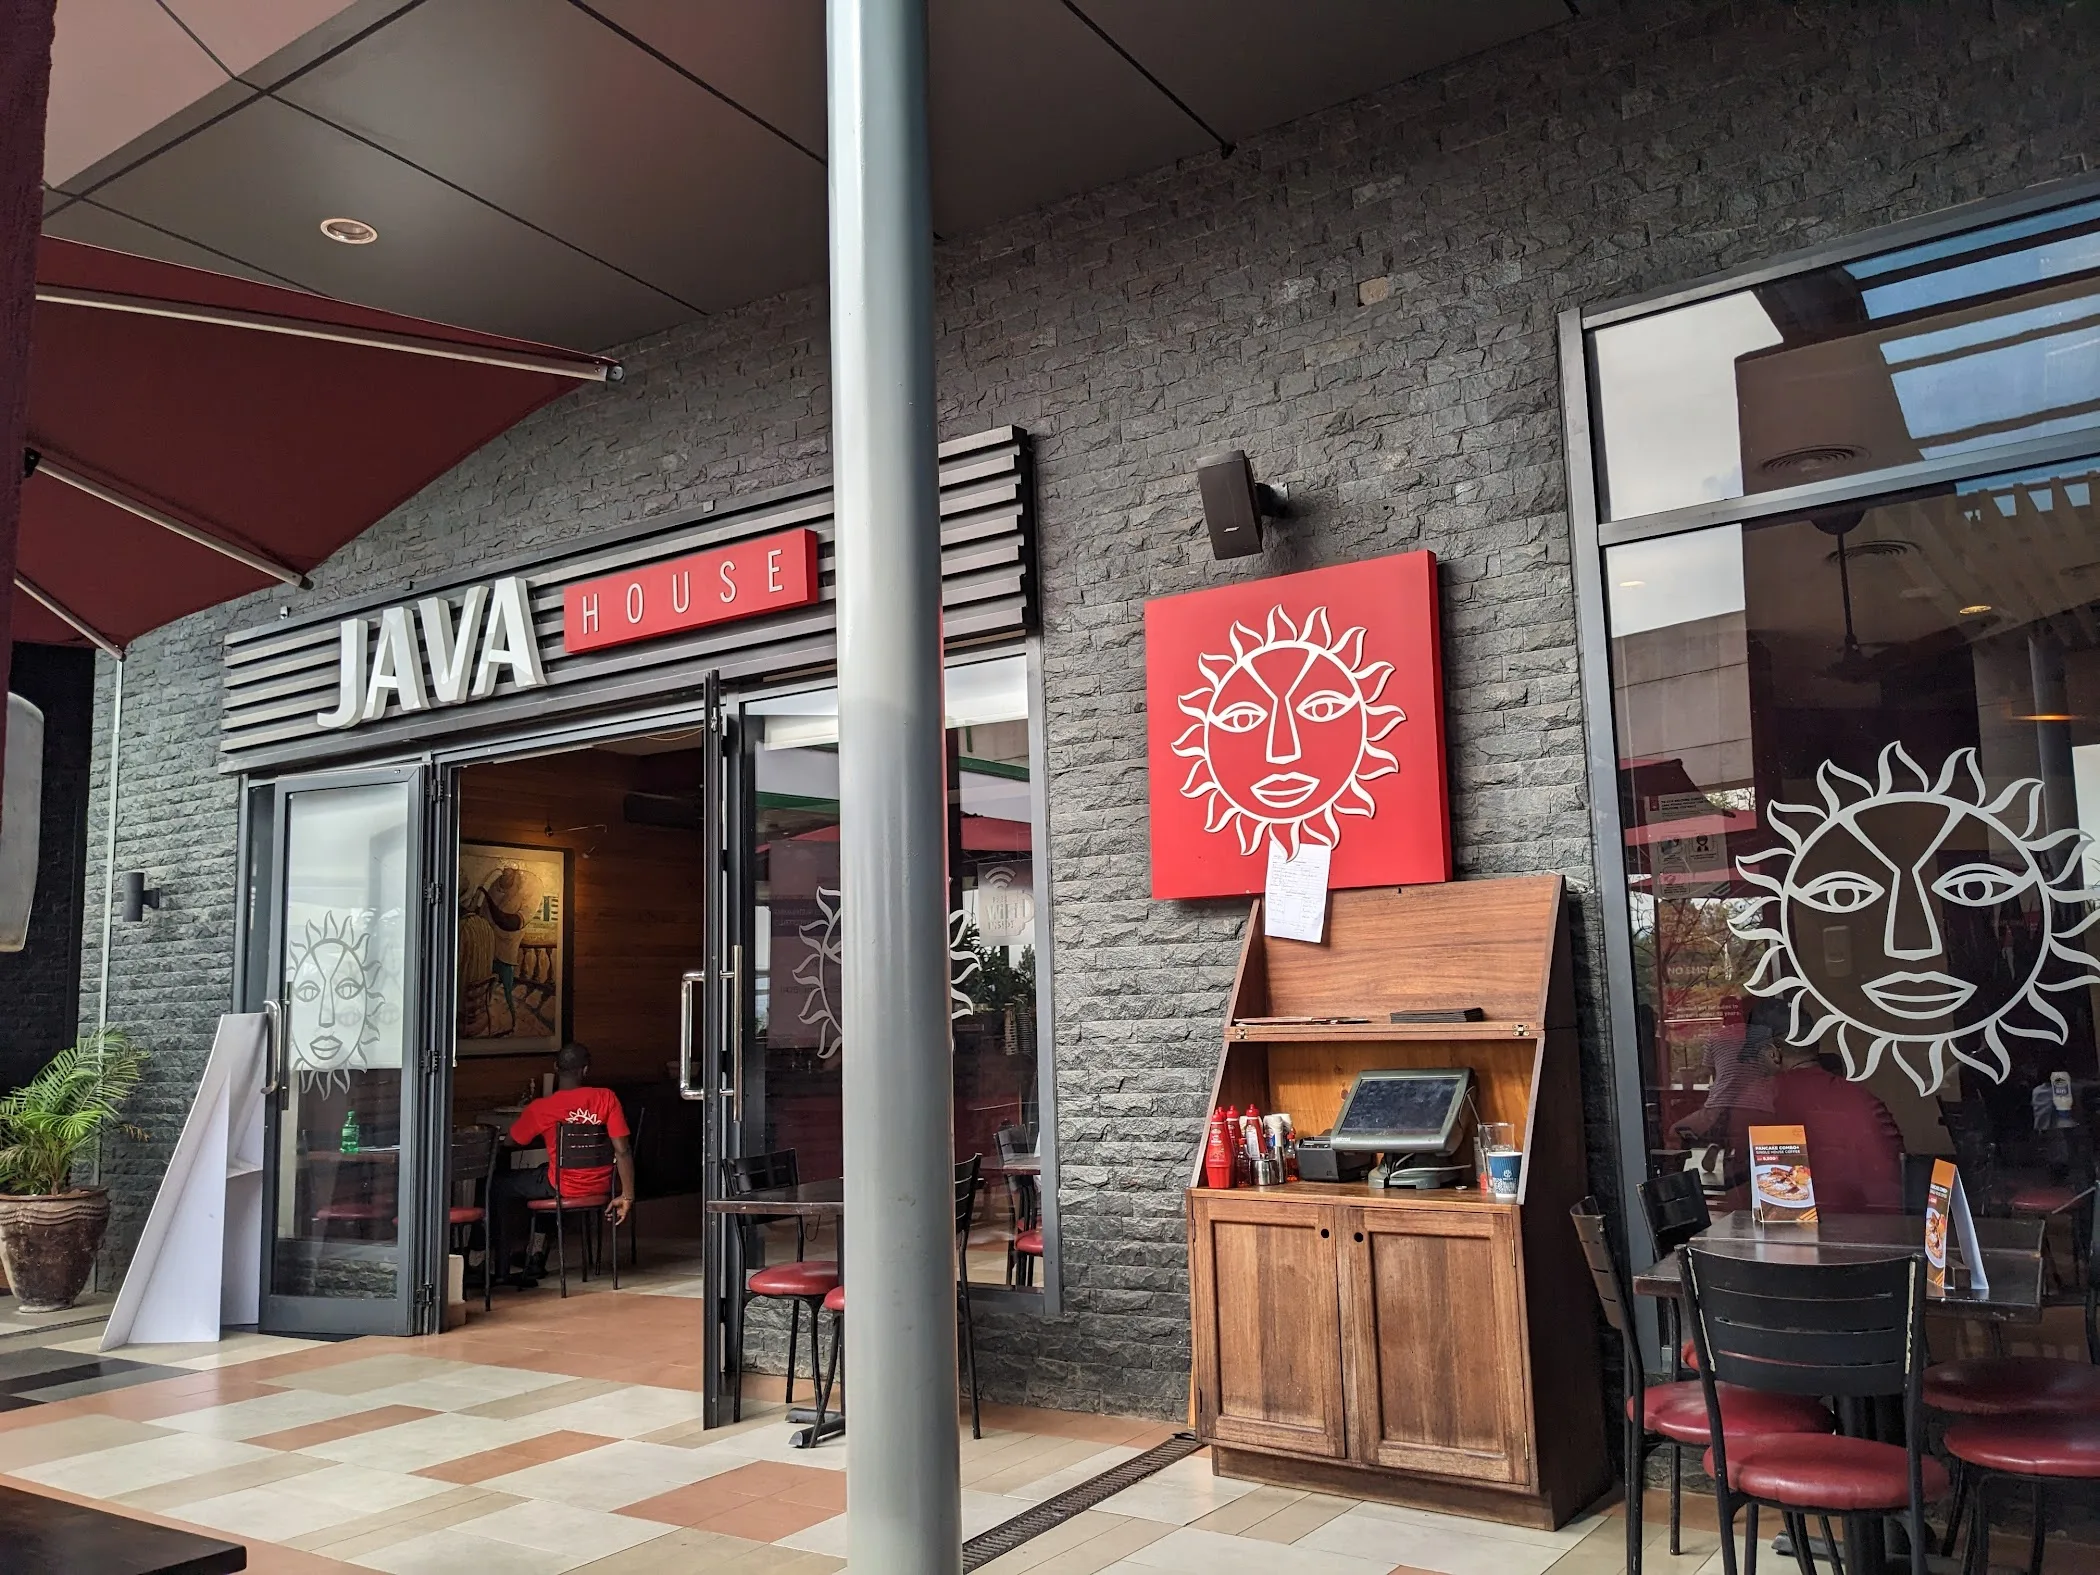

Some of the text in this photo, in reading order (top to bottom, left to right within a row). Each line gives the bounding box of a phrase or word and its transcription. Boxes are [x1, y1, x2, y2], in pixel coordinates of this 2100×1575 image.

[316, 548, 786, 730] JAVA HOUSE
[1667, 967, 1684, 975] NO
